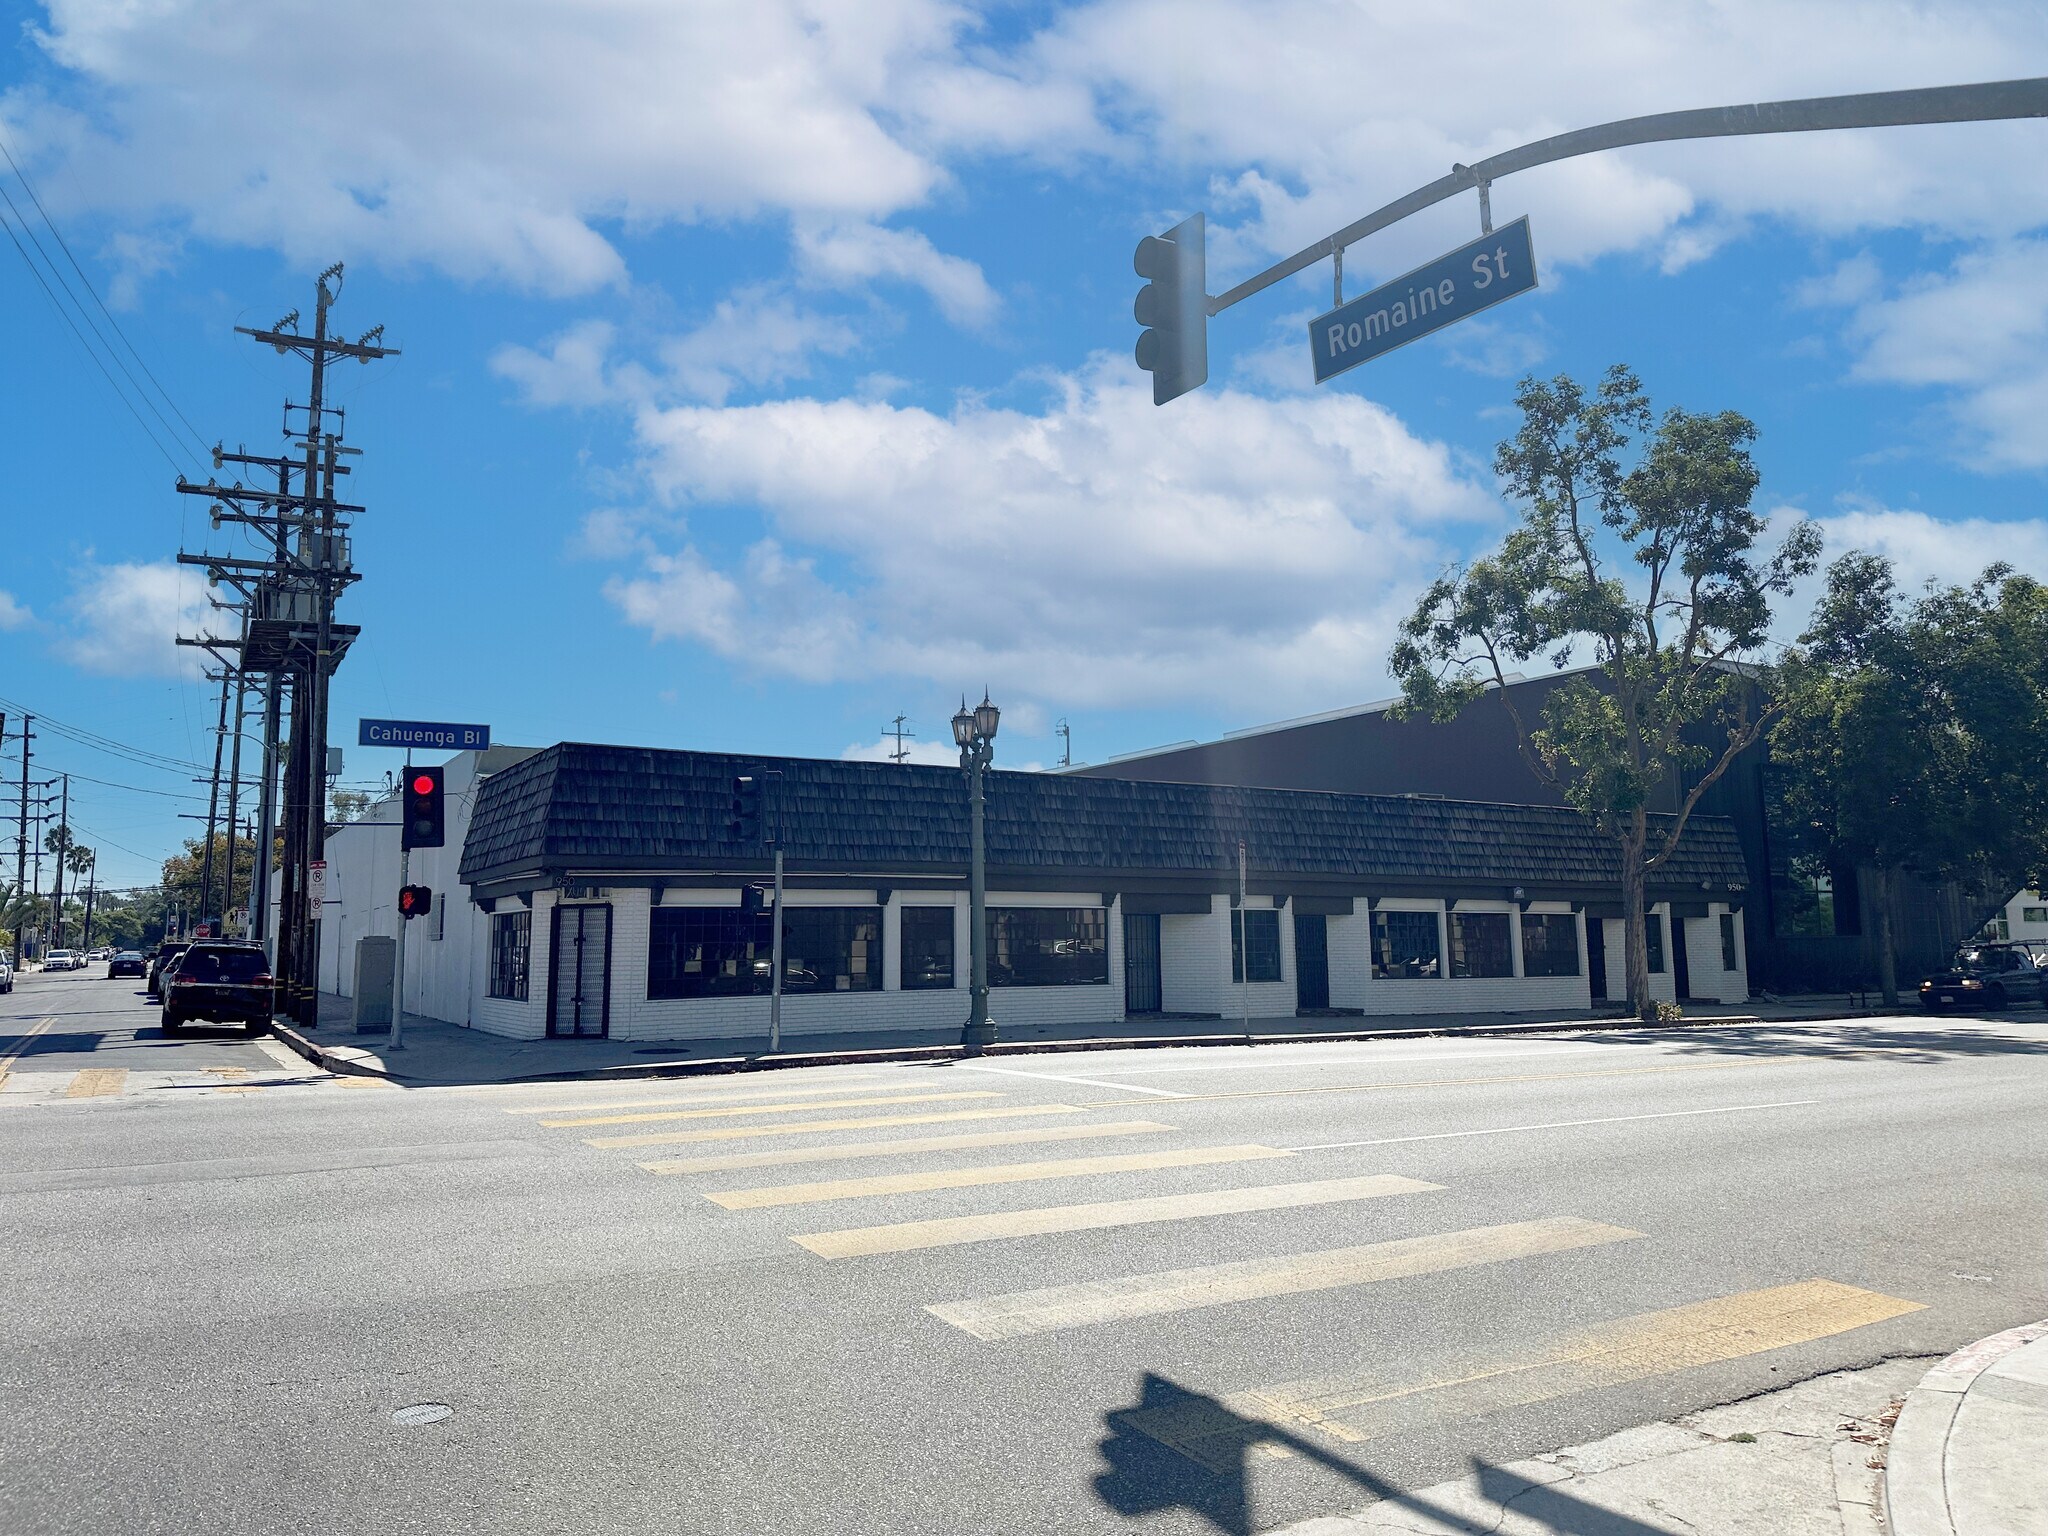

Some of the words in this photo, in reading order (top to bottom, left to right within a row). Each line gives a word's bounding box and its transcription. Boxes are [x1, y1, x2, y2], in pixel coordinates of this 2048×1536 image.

[1328, 278, 1456, 357] Romaine
[1471, 246, 1510, 290] St
[369, 725, 455, 747] Cahuenga
[464, 730, 480, 745] Bl
[556, 876, 576, 887] 950
